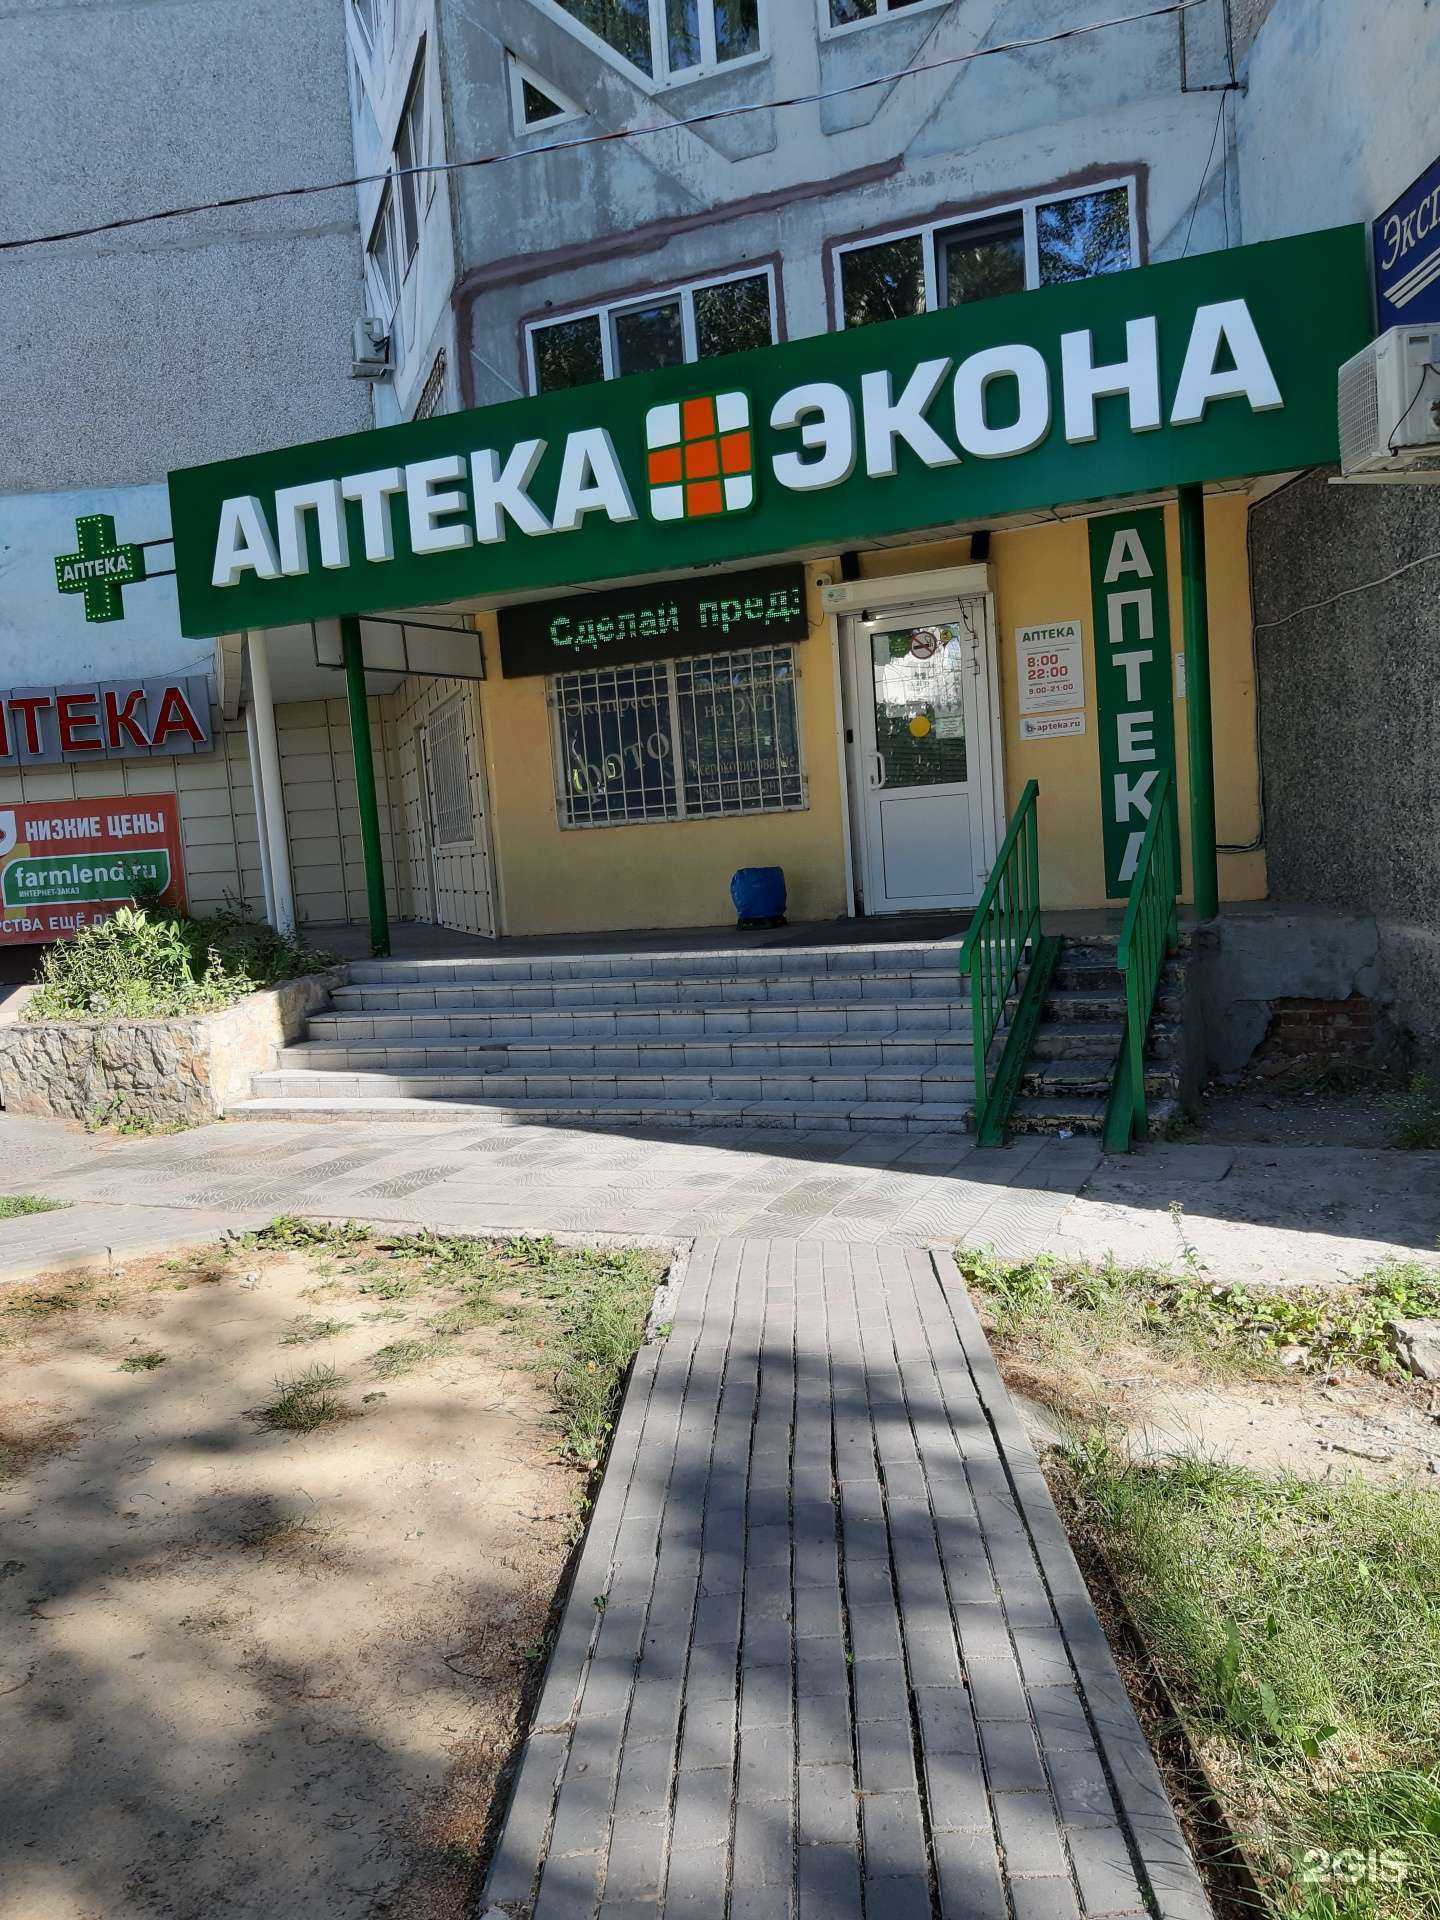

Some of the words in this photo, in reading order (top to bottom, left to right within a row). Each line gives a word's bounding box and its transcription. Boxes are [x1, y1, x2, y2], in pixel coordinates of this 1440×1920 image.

[211, 427, 638, 588] АПТЕКА
[769, 298, 1283, 494] ЭКОНА
[63, 555, 129, 582] АПТЕКА
[550, 600, 679, 652] Сделай
[1022, 626, 1075, 643] АПТЕКА
[1027, 654, 1059, 668] 8:00
[1027, 665, 1068, 680] 22:00
[0, 687, 206, 757] ТЕКА
[25, 816, 101, 841] НИЗКИЕ
[107, 812, 165, 838] ЦЕНЫ
[0, 918, 43, 933] СТВА
[49, 913, 85, 930] ЕЩЁ
